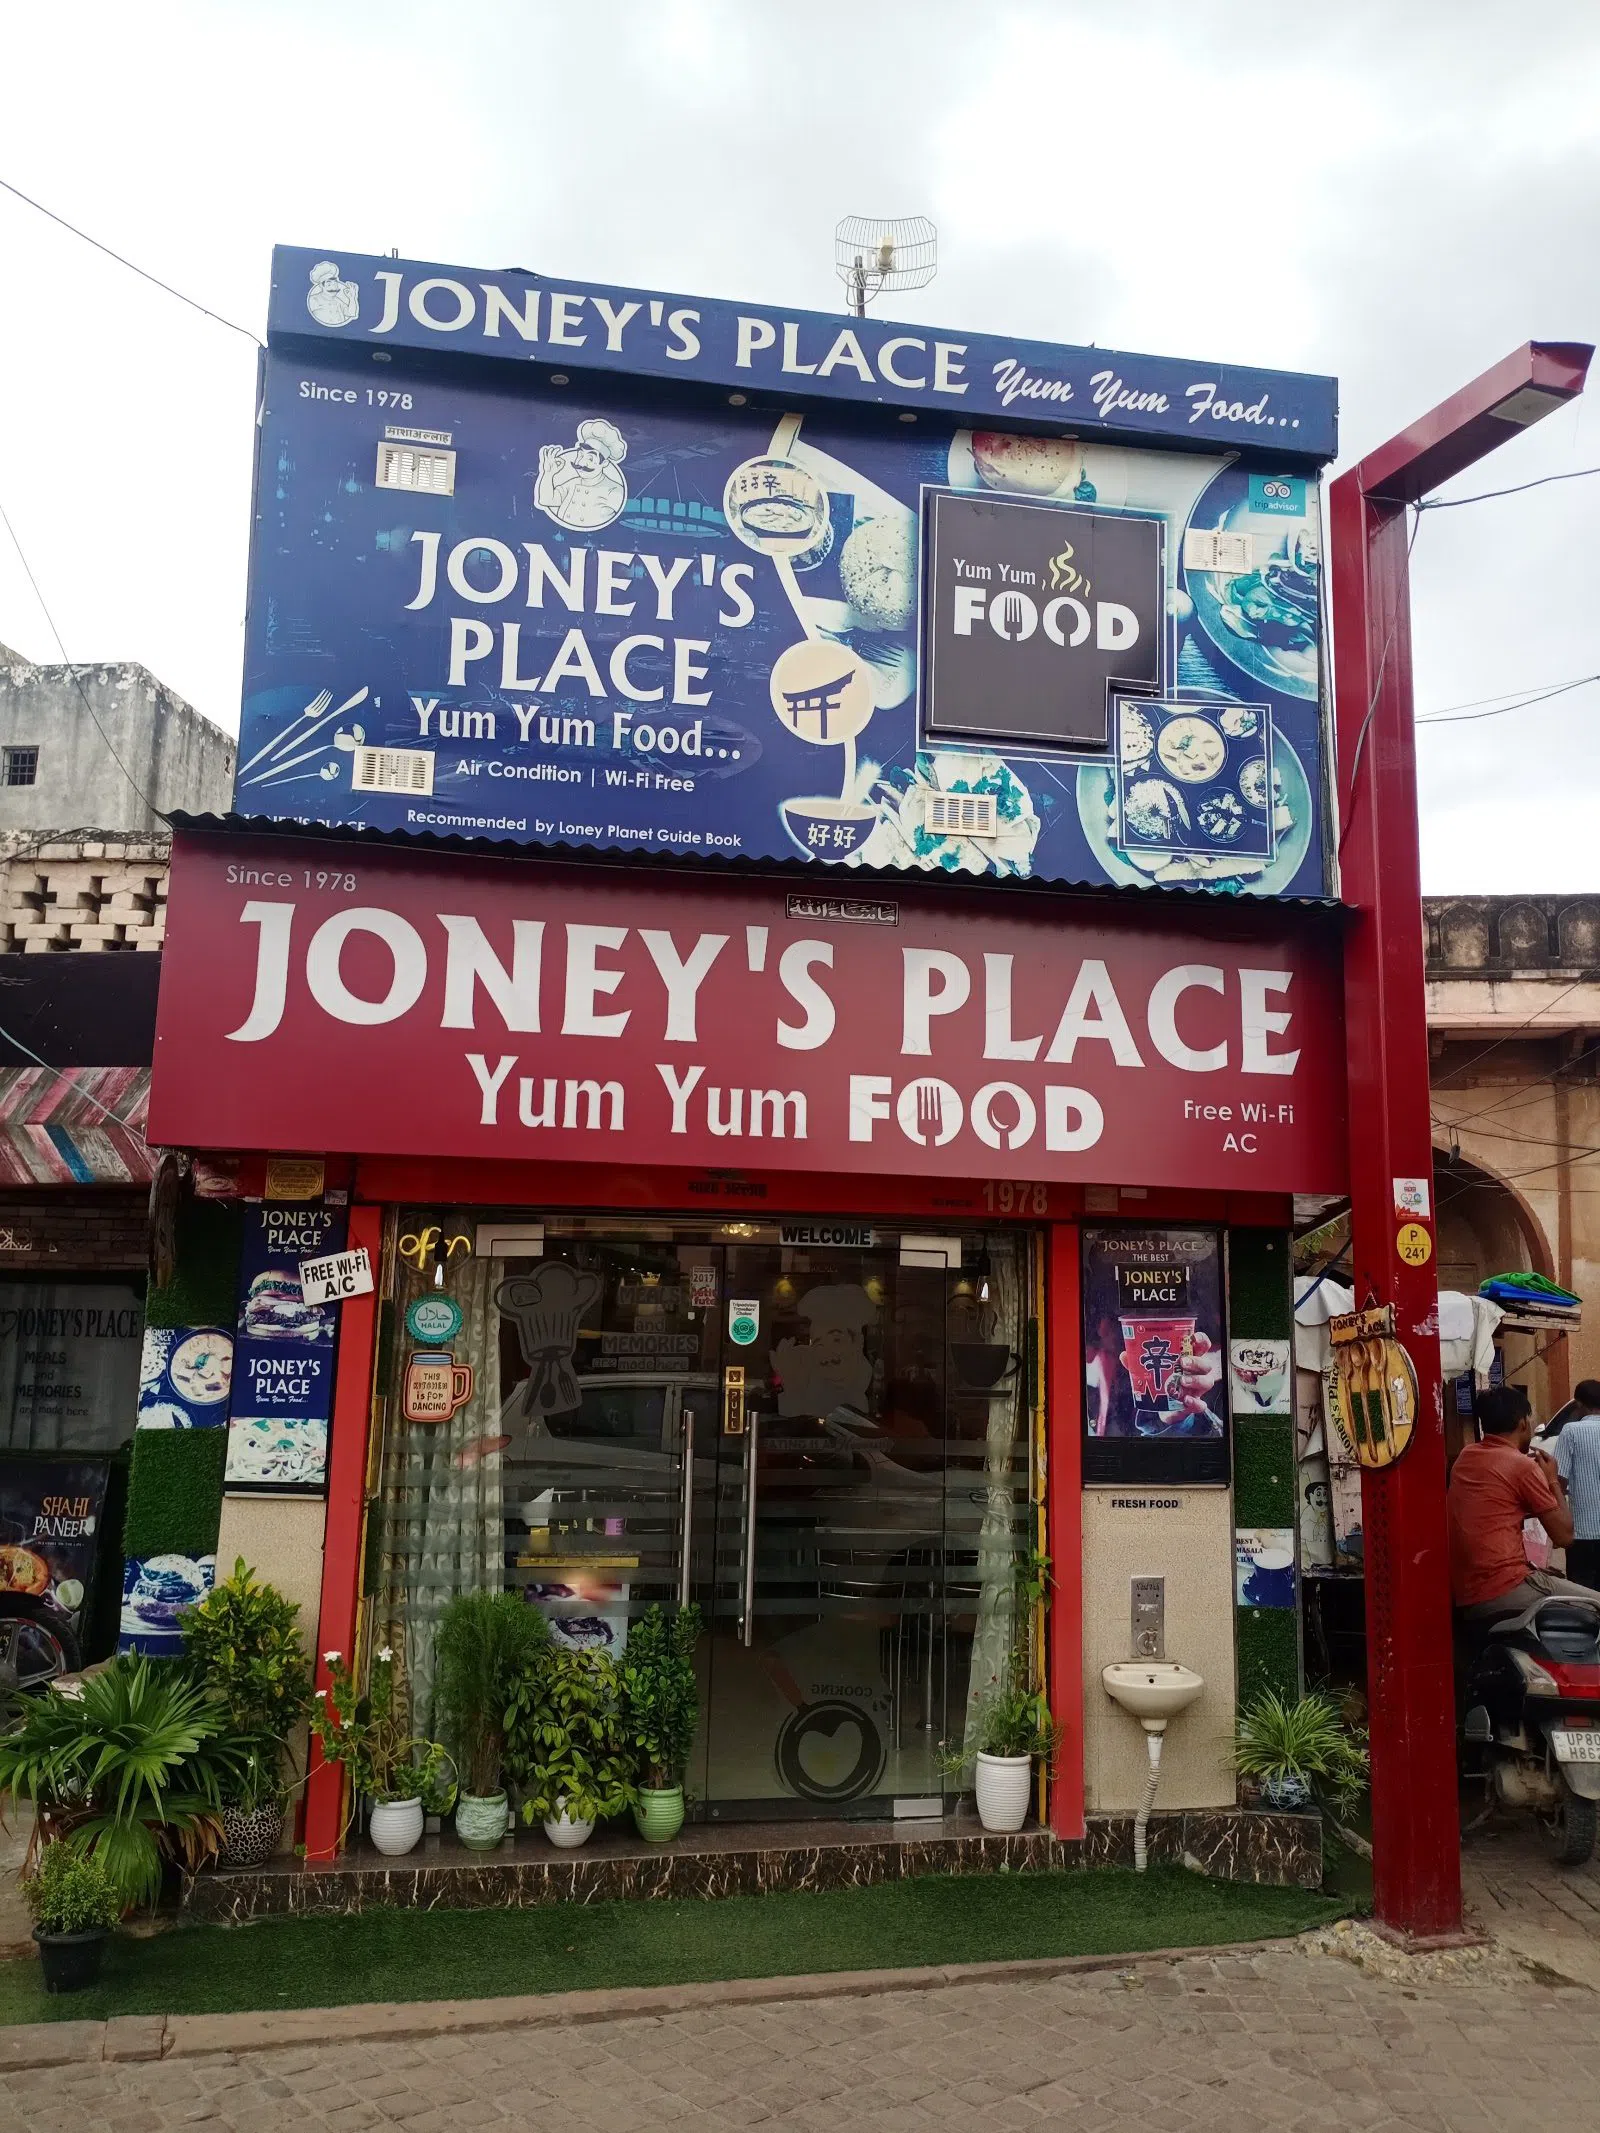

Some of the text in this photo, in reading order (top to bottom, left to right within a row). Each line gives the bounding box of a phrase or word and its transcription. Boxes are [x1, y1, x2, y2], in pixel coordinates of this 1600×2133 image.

[370, 271, 970, 395] JONEY'S PLACE
[299, 381, 413, 410] Since 1978
[992, 358, 1074, 407] Yum
[1089, 370, 1170, 414] Yum
[1254, 500, 1298, 513] tripadvisor
[404, 530, 756, 628] JONEY'S
[952, 557, 1037, 586] Yum Yum
[952, 585, 1140, 651] FOOD
[447, 617, 715, 706] PLACE
[411, 696, 741, 760] Yum Yum Food...
[455, 758, 695, 793] Air Condition Wi-Fi Free
[407, 809, 742, 848] Recommended by Loney Planet Guide Book
[808, 822, 857, 850] 好好
[226, 864, 357, 892] Since 1978
[224, 900, 1301, 1076] JONEY'S PLACE
[464, 1053, 1105, 1153] Yum Yum FOOD
[1184, 1099, 1294, 1125] Free Wi-Fi
[1222, 1134, 1258, 1154] AC
[982, 1180, 1048, 1215] 1978
[260, 1210, 333, 1227] JONEY'S
[267, 1229, 322, 1246] PLACE
[781, 1225, 872, 1246] WELCOME
[1103, 1239, 1198, 1252] JONEY'S PLACE
[1410, 1230, 1418, 1242] P
[400, 1226, 472, 1270] opn
[1132, 1253, 1169, 1262] THE BEST
[1405, 1246, 1425, 1260] 241
[303, 1254, 368, 1285] FREE WI-FI
[693, 1273, 714, 1283] 2017
[1125, 1270, 1182, 1286] JONEY'S
[325, 1276, 356, 1299] A/C
[1133, 1288, 1177, 1302] PLACE
[16, 1308, 138, 1341] JONEY'S PLACE
[24, 1351, 67, 1365] MEALS
[248, 1359, 321, 1377] JONEY'S
[256, 1378, 310, 1395] PLACE
[423, 1372, 441, 1381] THIS
[16, 1384, 82, 1398] MEMORIES
[416, 1391, 425, 1400] is
[412, 1402, 447, 1411] DANCING
[731, 1390, 739, 1429] PULL
[41, 1496, 90, 1518] SHAHI
[1111, 1499, 1179, 1509] FRESH FOOD
[33, 1515, 92, 1537] PANEER
